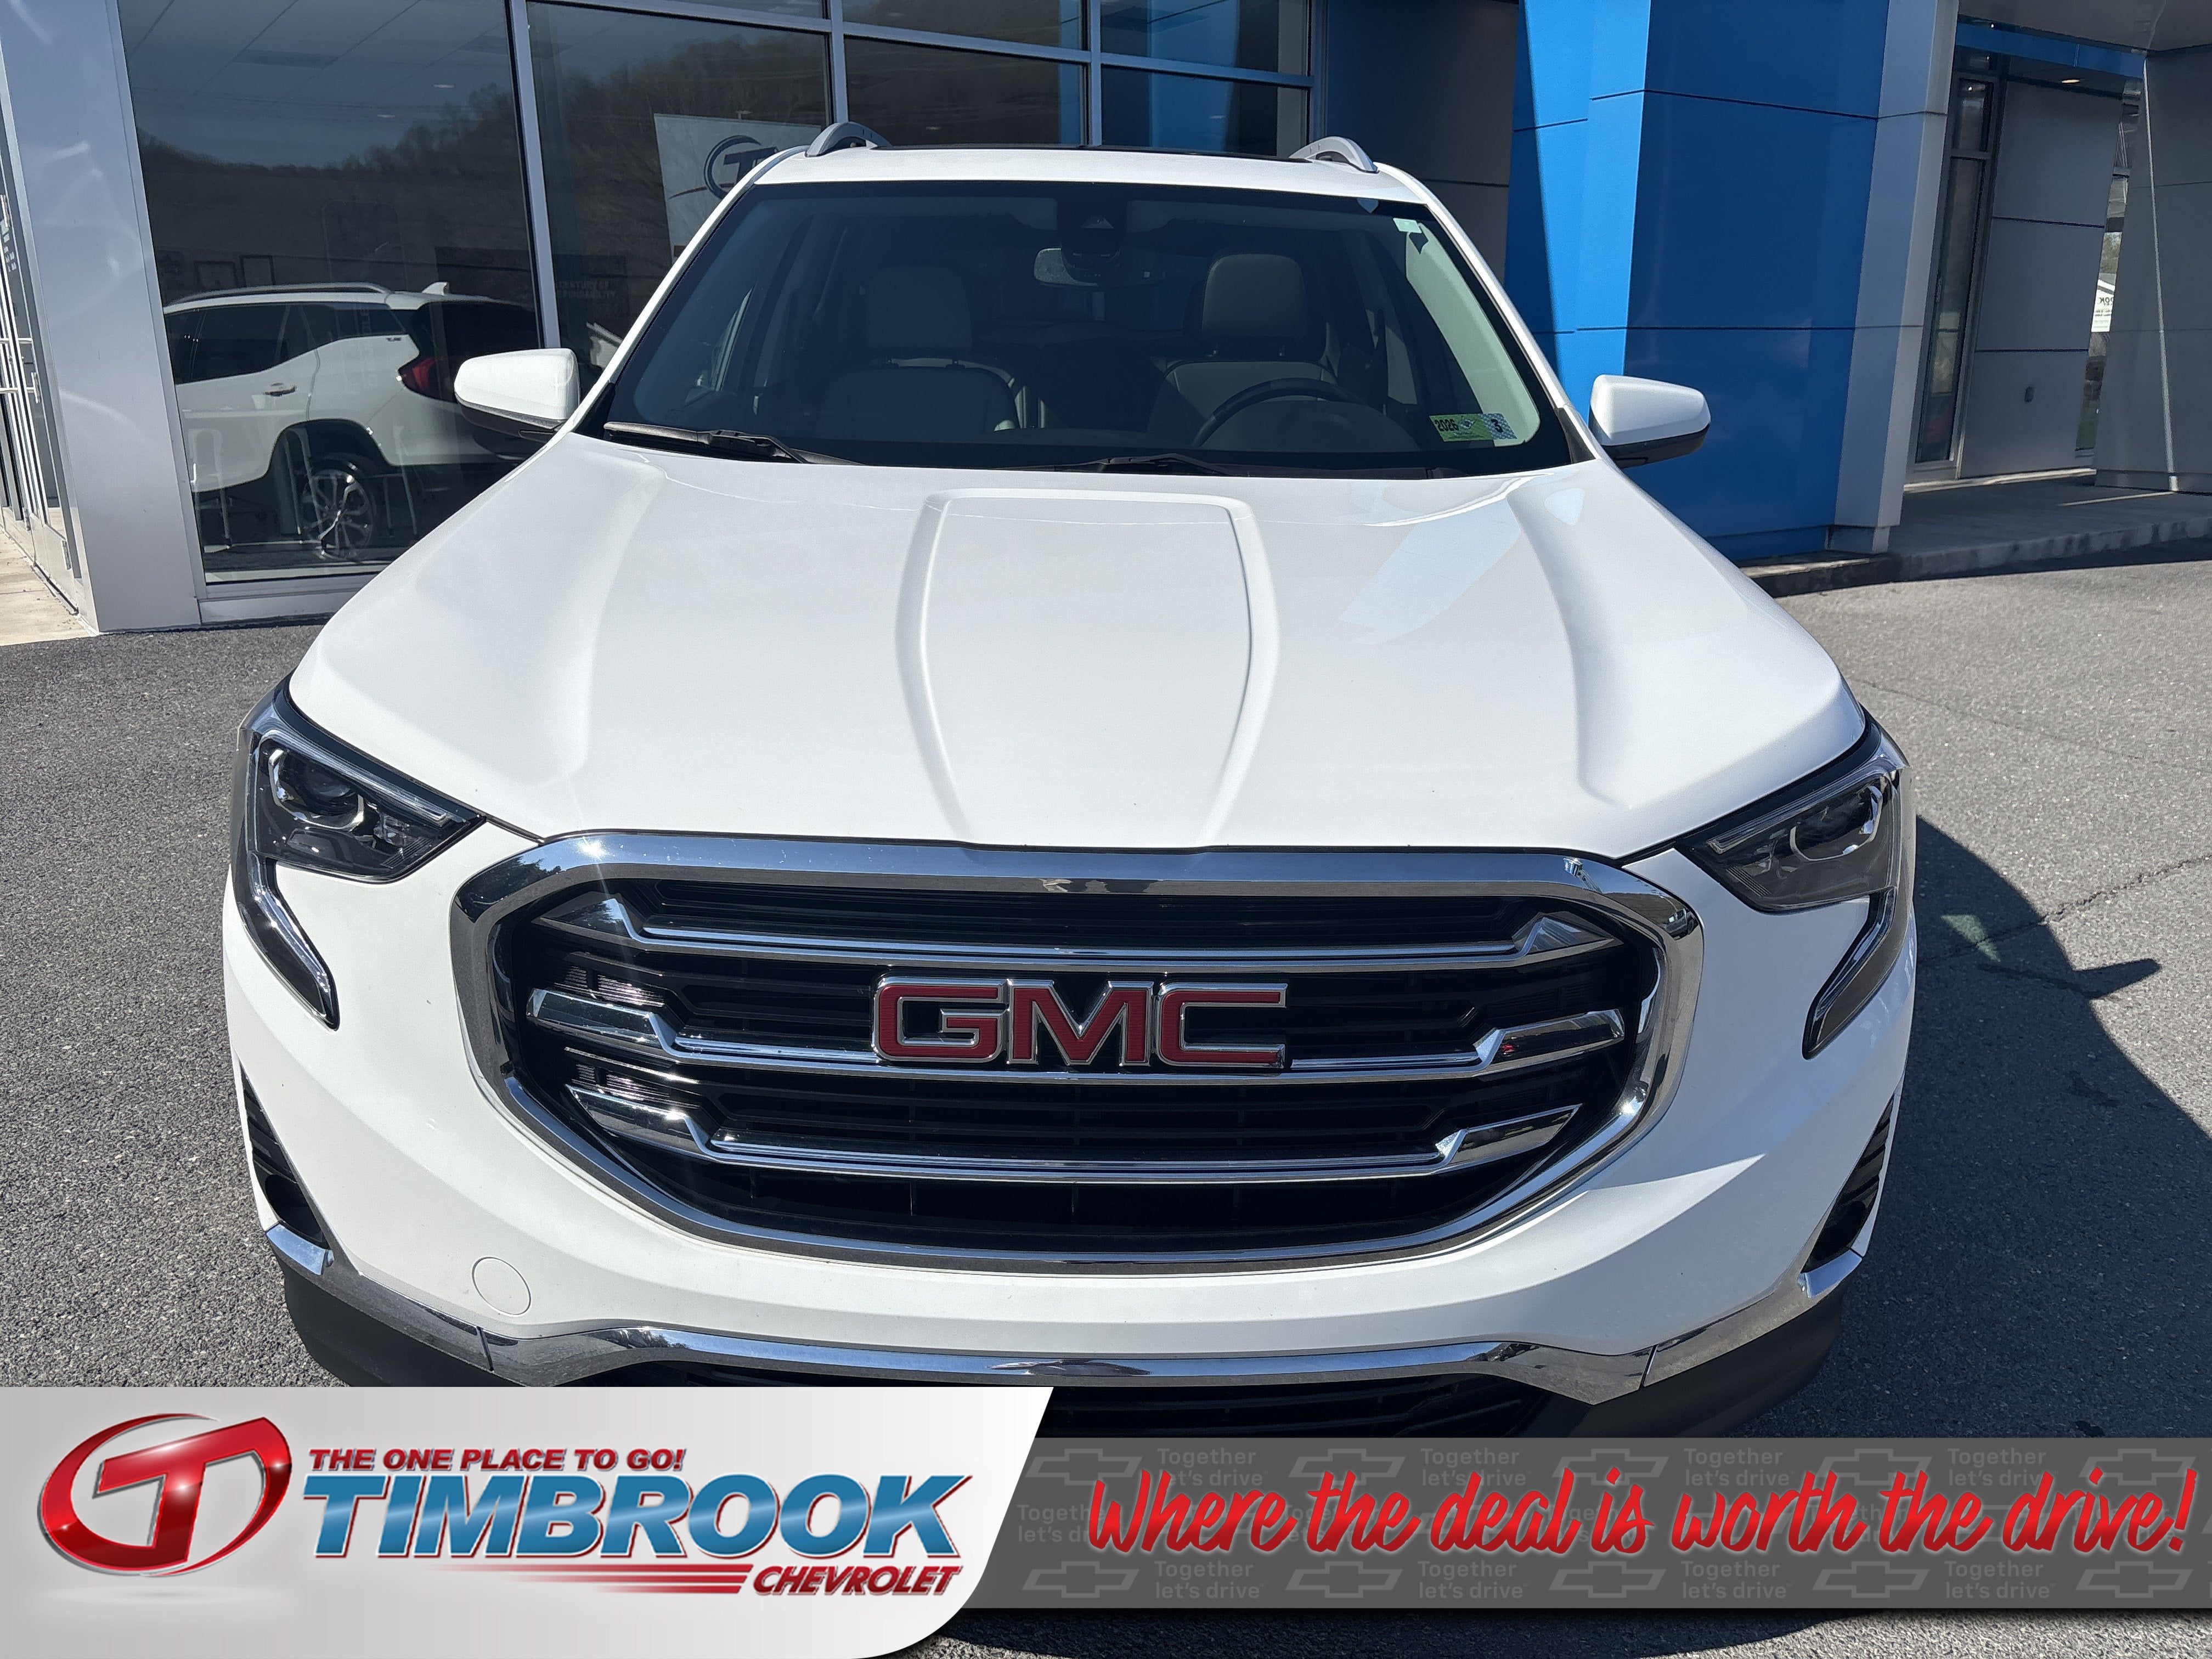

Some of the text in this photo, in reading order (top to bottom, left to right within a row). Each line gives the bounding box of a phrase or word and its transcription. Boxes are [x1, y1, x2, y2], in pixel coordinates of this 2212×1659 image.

[1434, 418, 1504, 433] 2026 3
[871, 975, 1288, 1069] GMC
